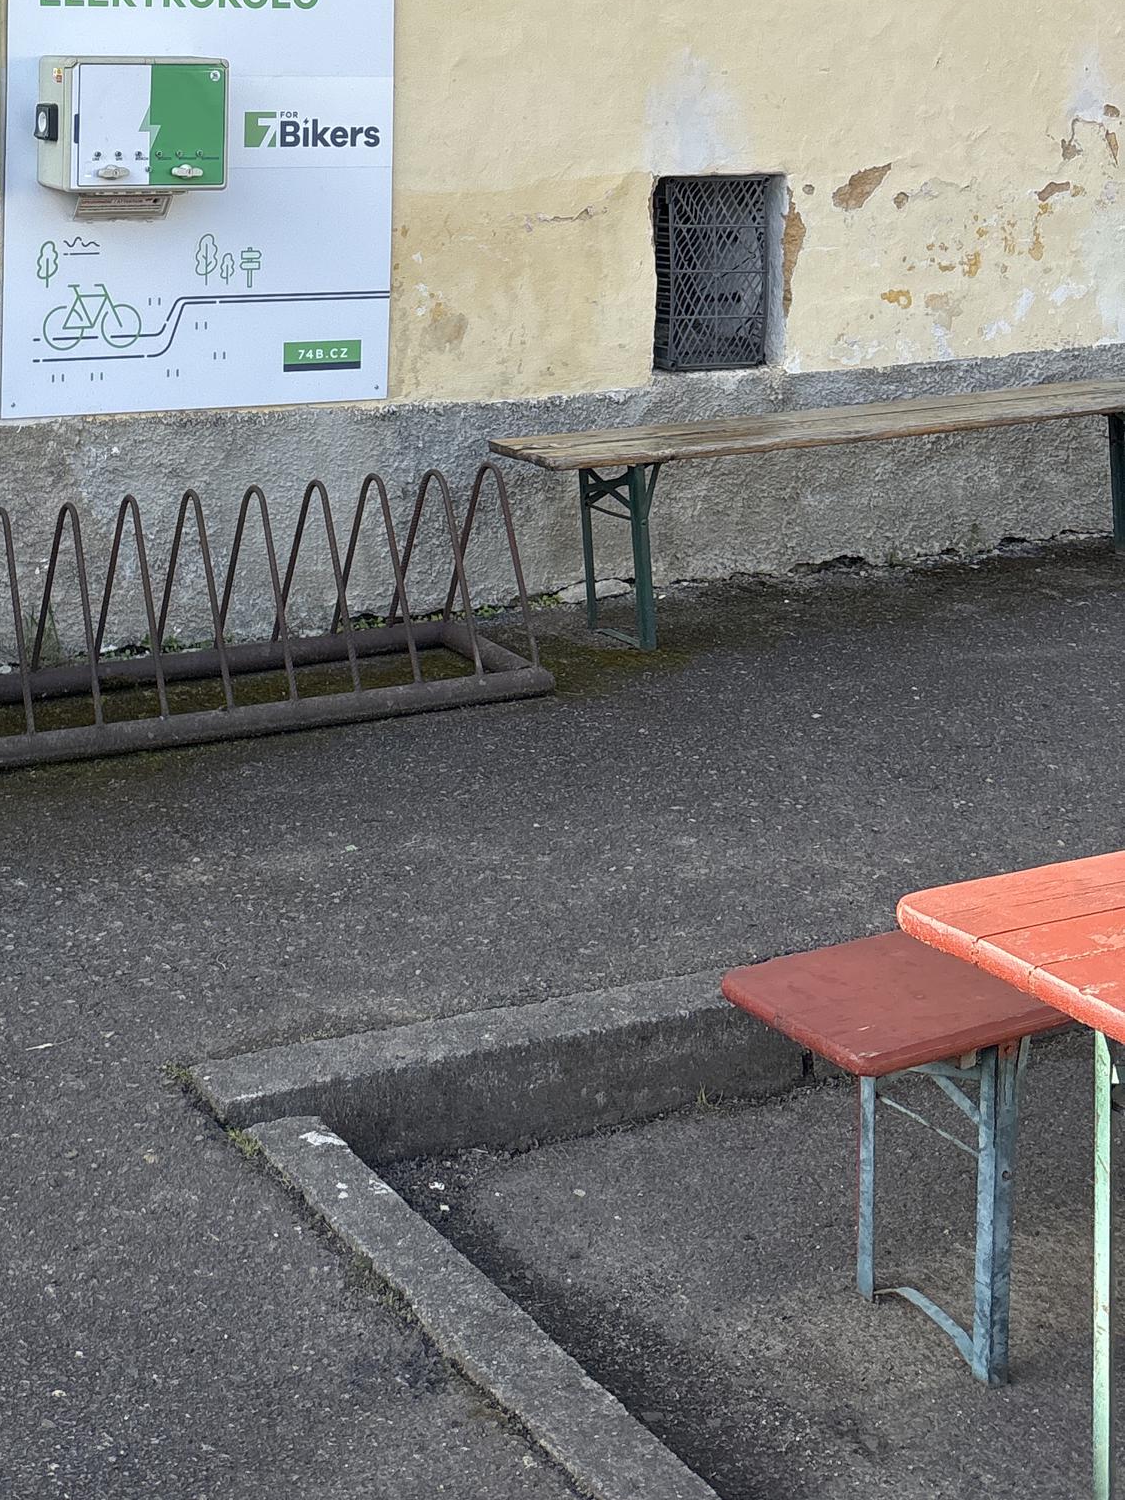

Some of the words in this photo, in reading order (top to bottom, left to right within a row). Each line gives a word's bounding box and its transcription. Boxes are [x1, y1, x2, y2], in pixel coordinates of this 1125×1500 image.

[280, 111, 298, 119] FOR
[280, 117, 380, 148] Bikers
[298, 347, 348, 360] 74B.CZ
